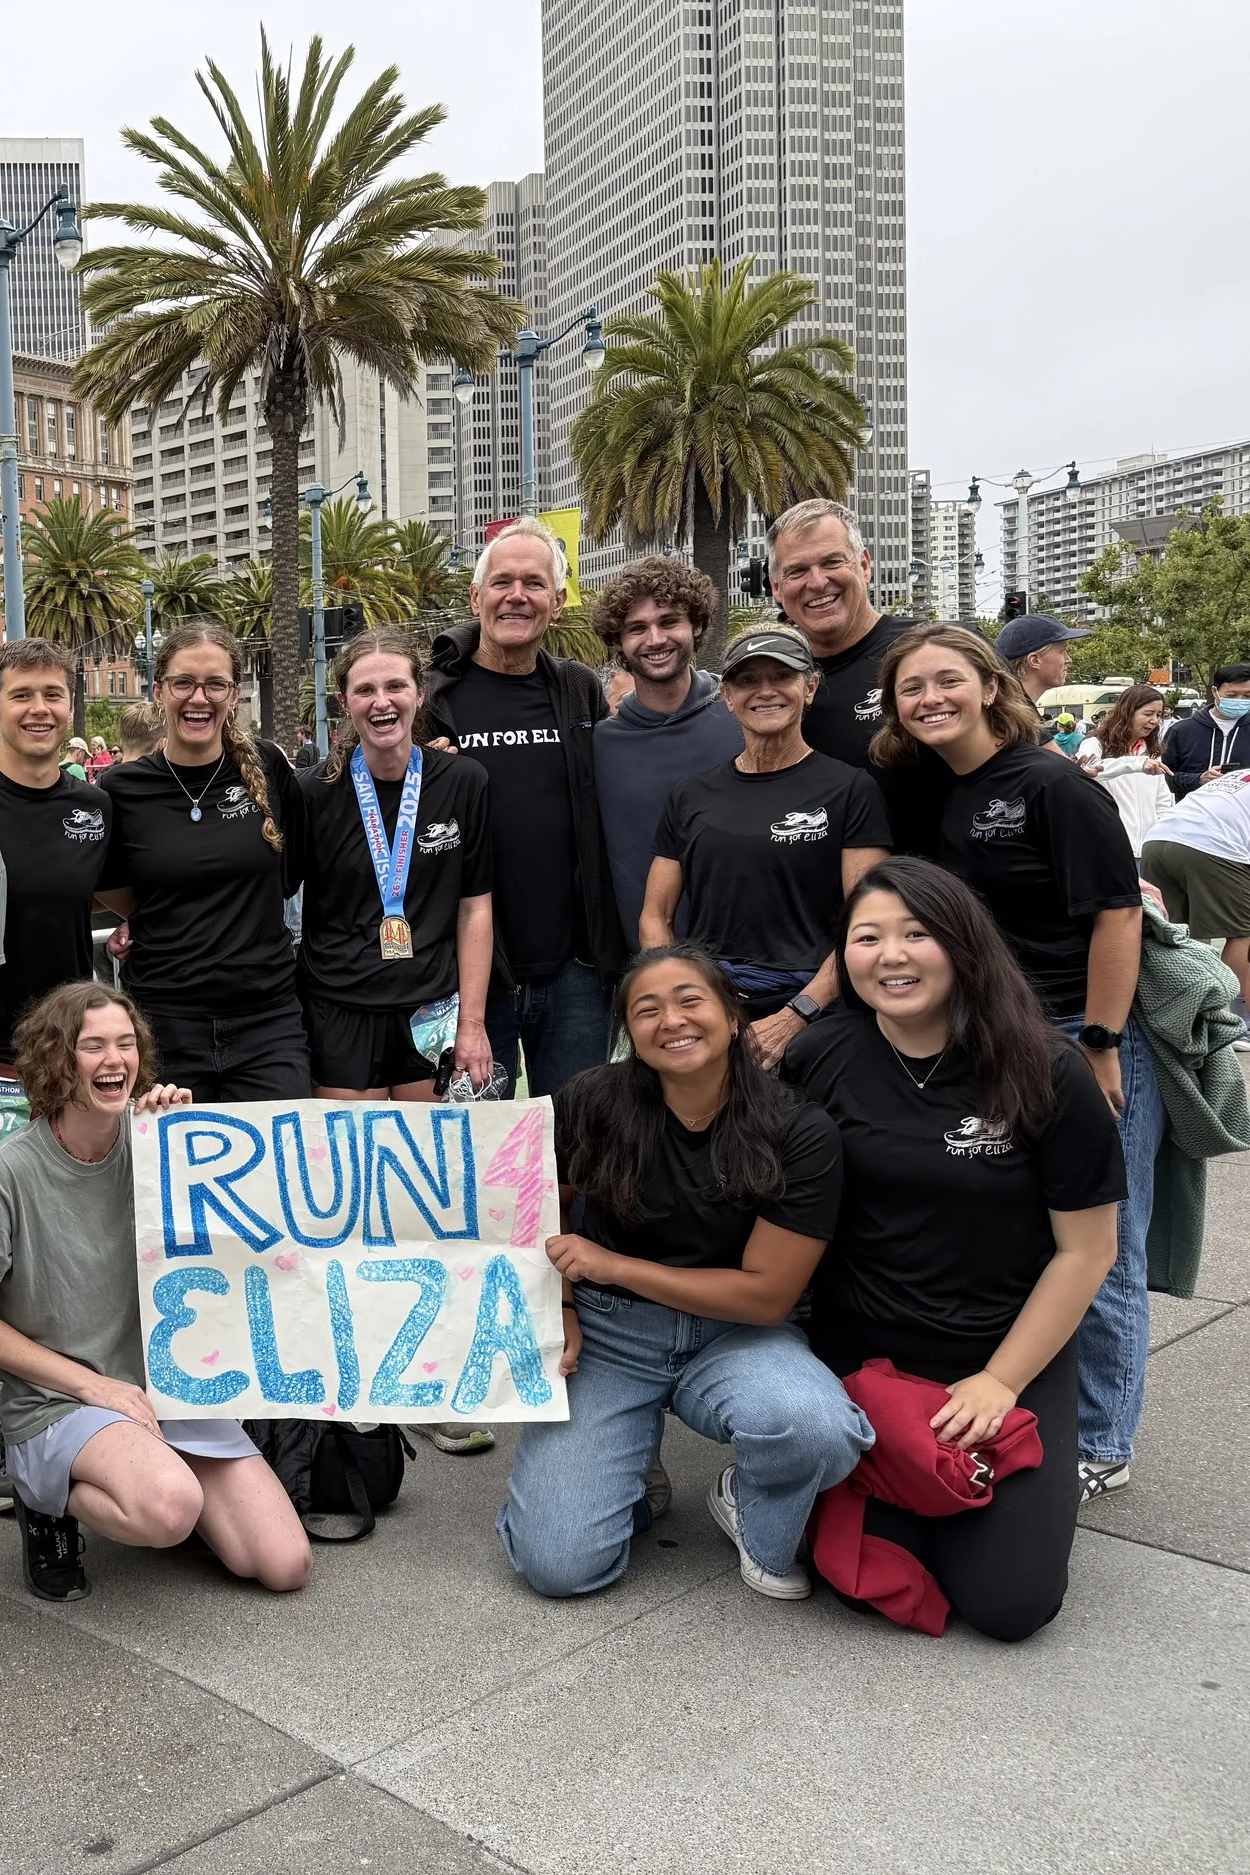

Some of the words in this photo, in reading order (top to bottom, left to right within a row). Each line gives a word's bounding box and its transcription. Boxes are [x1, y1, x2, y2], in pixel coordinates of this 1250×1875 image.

[458, 732, 489, 749] UN
[492, 730, 529, 746] FOR
[354, 771, 375, 805] SAN
[398, 771, 422, 829] 2025
[222, 811, 238, 819] run
[240, 805, 250, 819] for
[64, 830, 78, 840] run
[771, 834, 787, 842] run
[789, 833, 802, 845] for
[803, 830, 828, 842] eliza
[970, 828, 983, 838] run
[984, 828, 997, 842] for
[395, 829, 409, 874] FINISHER
[420, 846, 433, 854] run
[444, 838, 461, 850] eliza
[391, 876, 402, 898] 26.2
[946, 1145, 965, 1156] run
[968, 1145, 982, 1159] for
[985, 1142, 1013, 1155] eliza
[158, 1107, 481, 1259] RUN
[482, 1107, 554, 1249] 4
[148, 1253, 553, 1415] ELIZA
